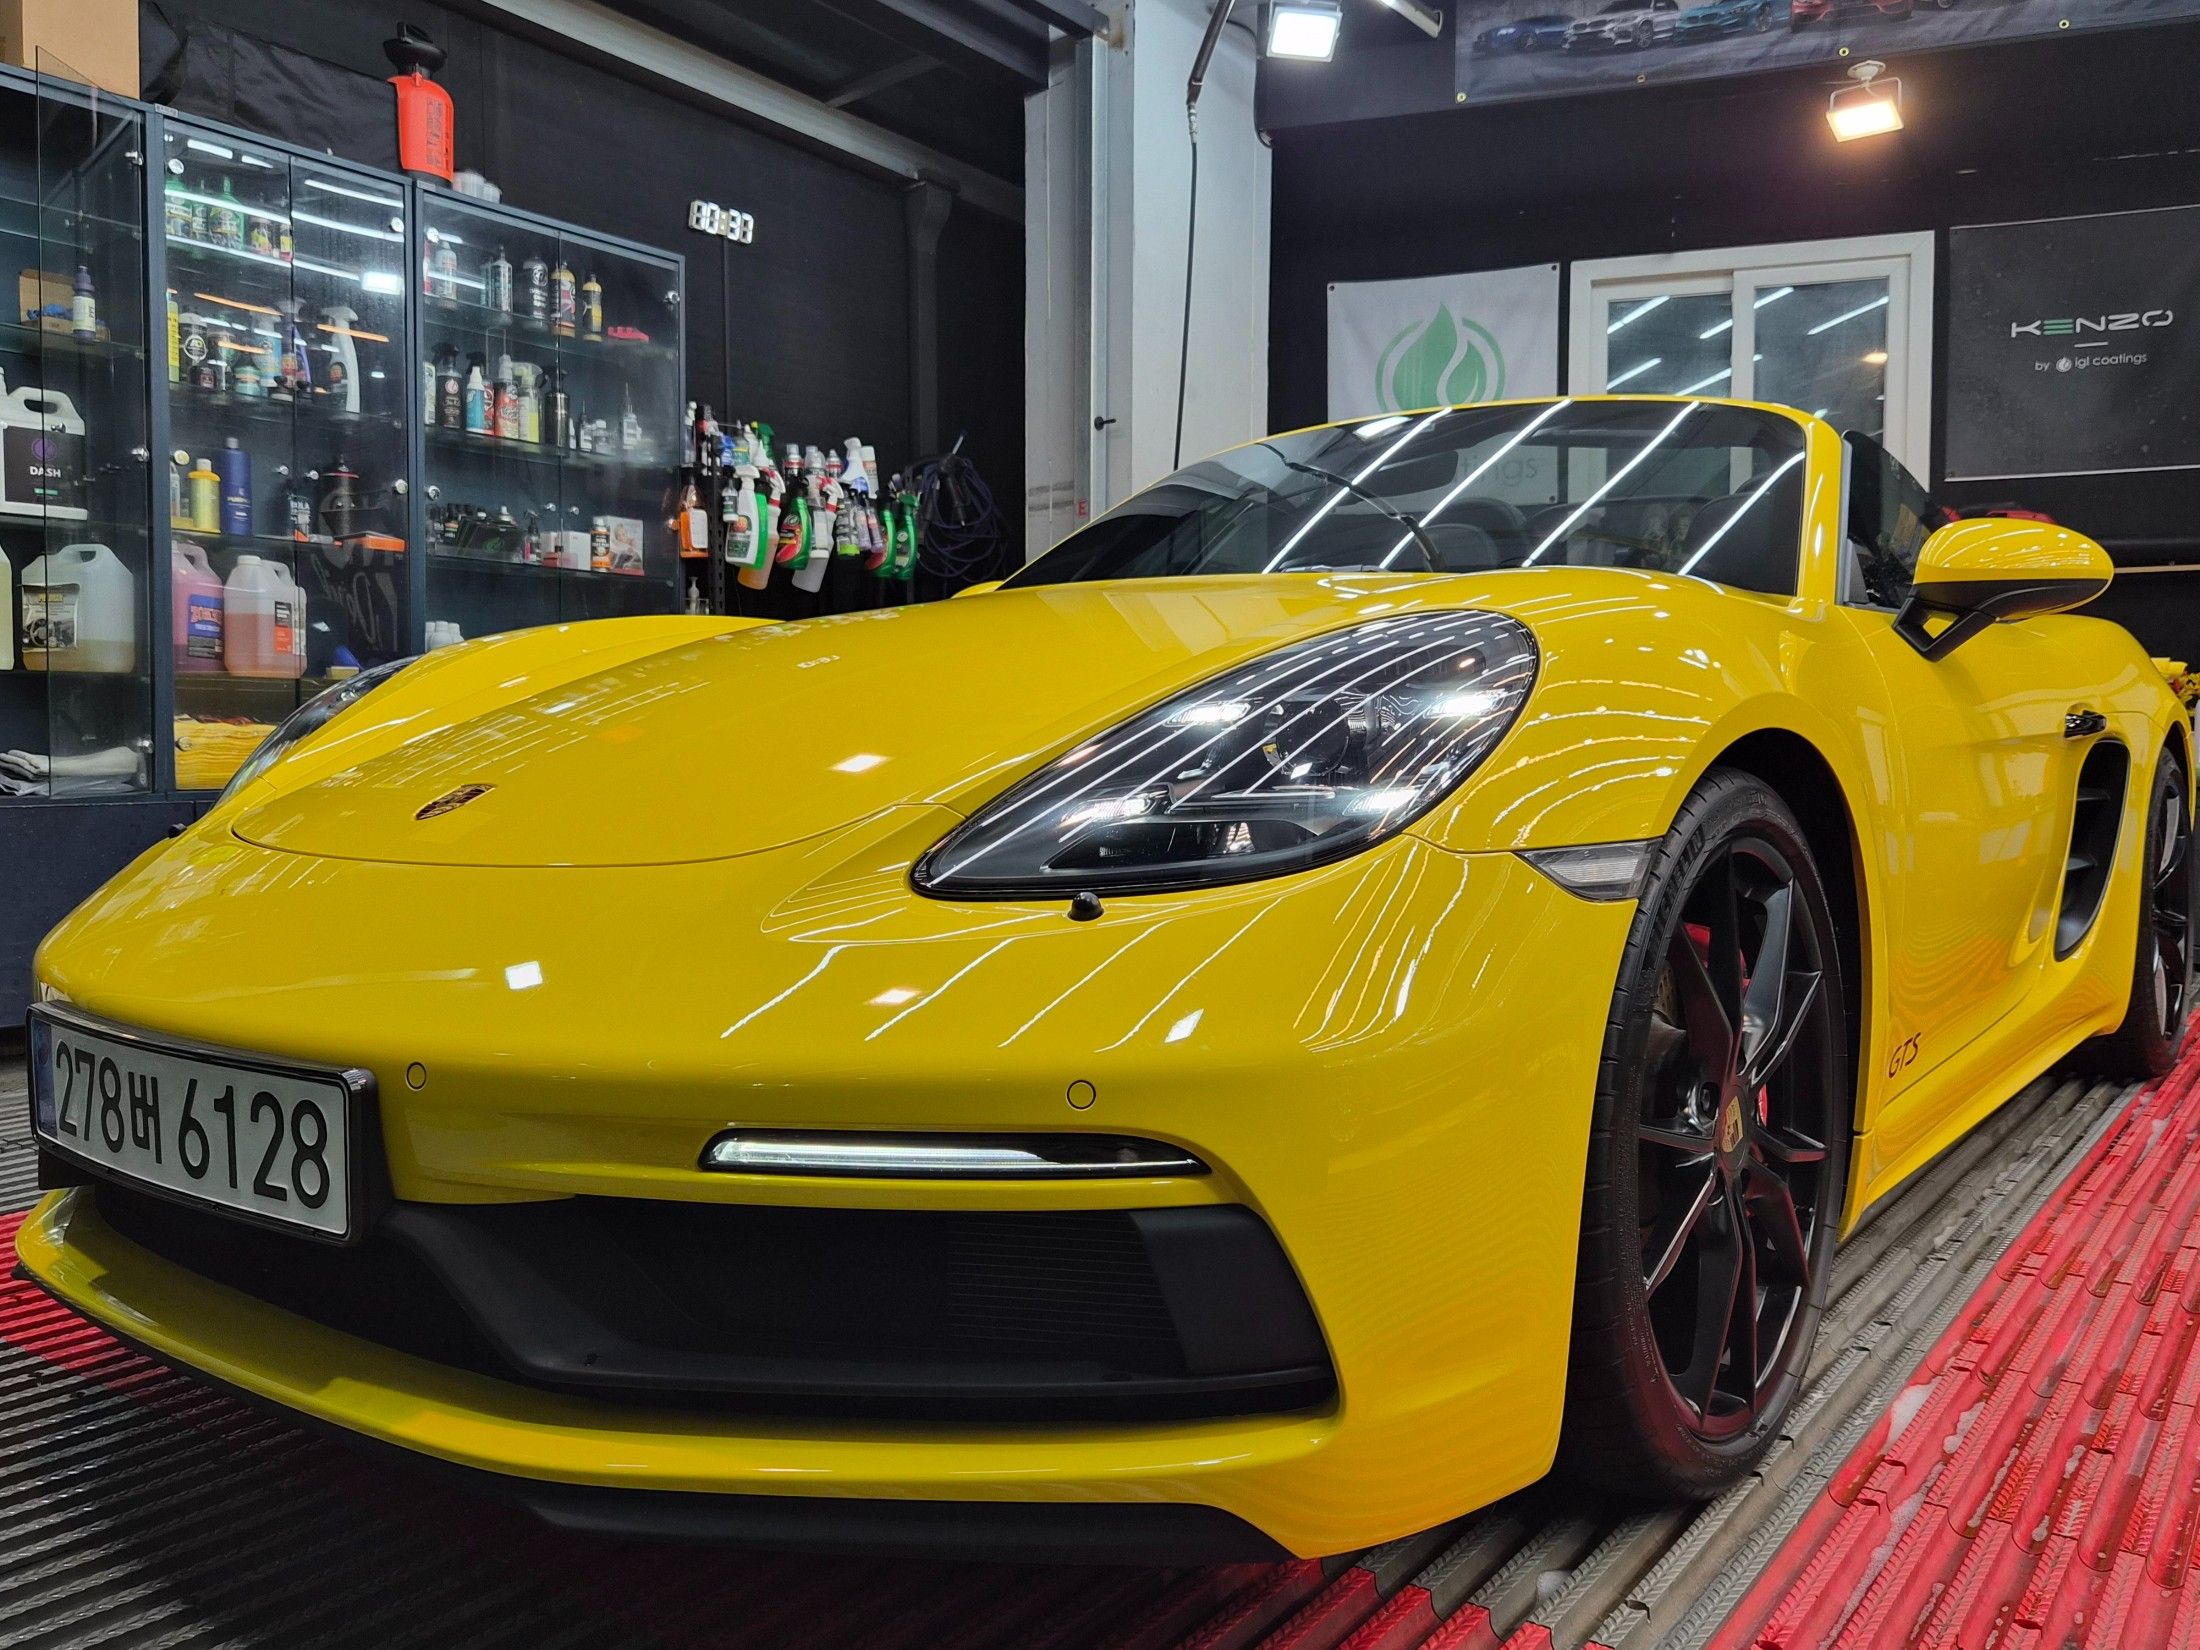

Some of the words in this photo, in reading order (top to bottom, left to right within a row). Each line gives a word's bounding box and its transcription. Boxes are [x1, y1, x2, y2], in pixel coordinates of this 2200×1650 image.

[689, 199, 754, 244] 10:37
[2011, 310, 2173, 338] KENZO
[2035, 360, 2050, 372] by
[2075, 356, 2090, 370] igl
[2092, 353, 2148, 367] coatings
[29, 465, 61, 478] DASH
[1458, 455, 1538, 487] tings
[1888, 1032, 1921, 1079] GTS
[56, 1041, 162, 1164] 278버
[178, 1078, 330, 1209] 6128
